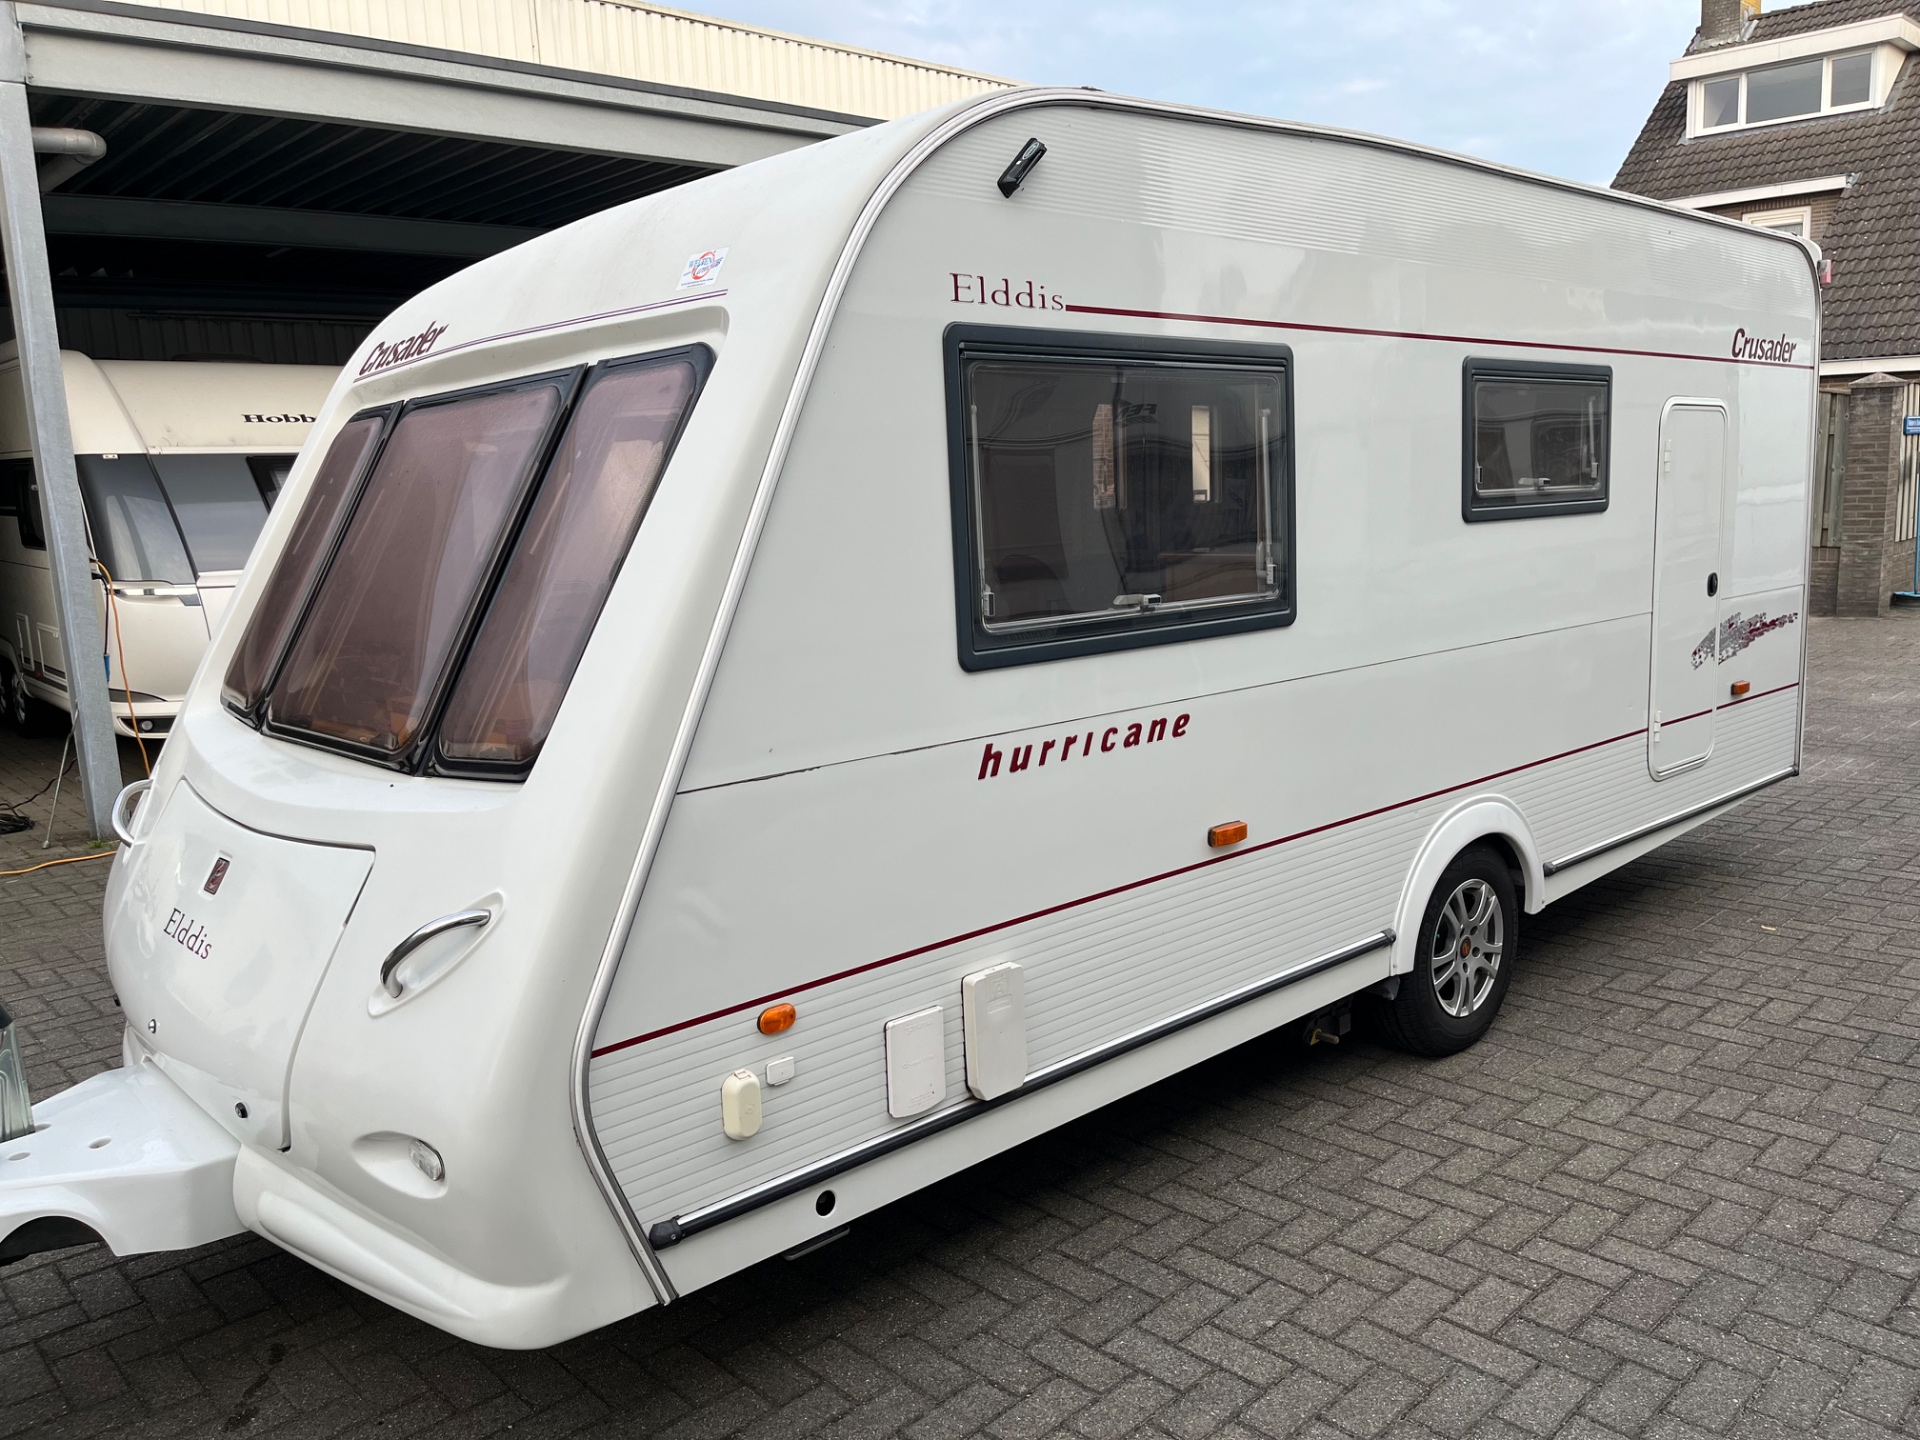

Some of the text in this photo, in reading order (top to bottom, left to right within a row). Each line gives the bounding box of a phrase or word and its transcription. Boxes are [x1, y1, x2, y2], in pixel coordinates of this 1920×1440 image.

[949, 272, 1064, 311] Elddis
[358, 320, 450, 376] Crusader
[1731, 327, 1797, 363] Crusader
[241, 413, 317, 423] Hobb
[977, 713, 1191, 781] hurricane
[163, 907, 212, 960] Elddis
